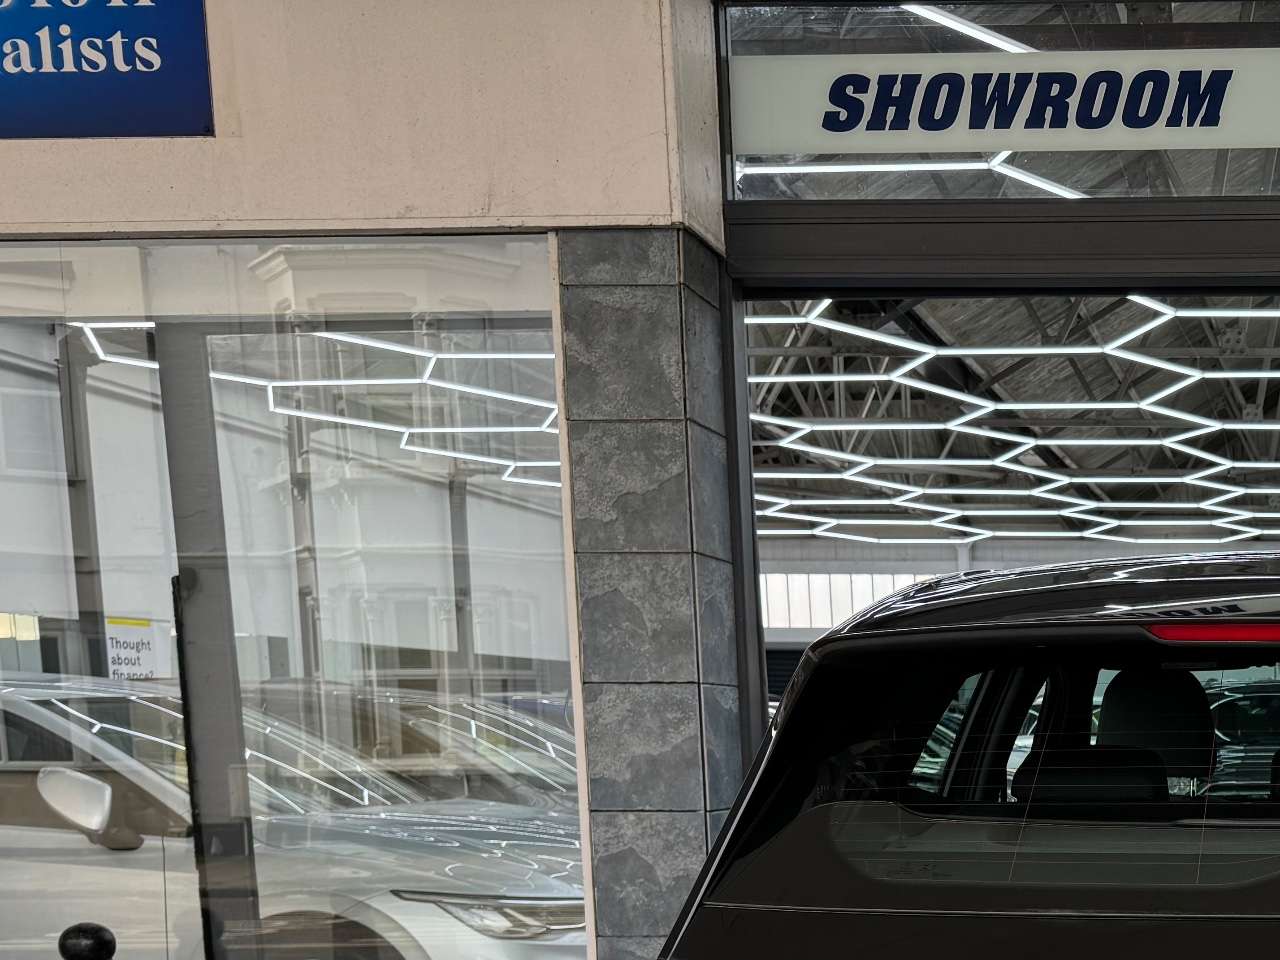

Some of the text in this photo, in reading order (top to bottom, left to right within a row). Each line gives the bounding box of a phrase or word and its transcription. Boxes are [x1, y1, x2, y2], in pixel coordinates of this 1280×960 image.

[821, 69, 1234, 132] SHOWROOM
[109, 637, 151, 653] Thought
[111, 654, 141, 666] about
